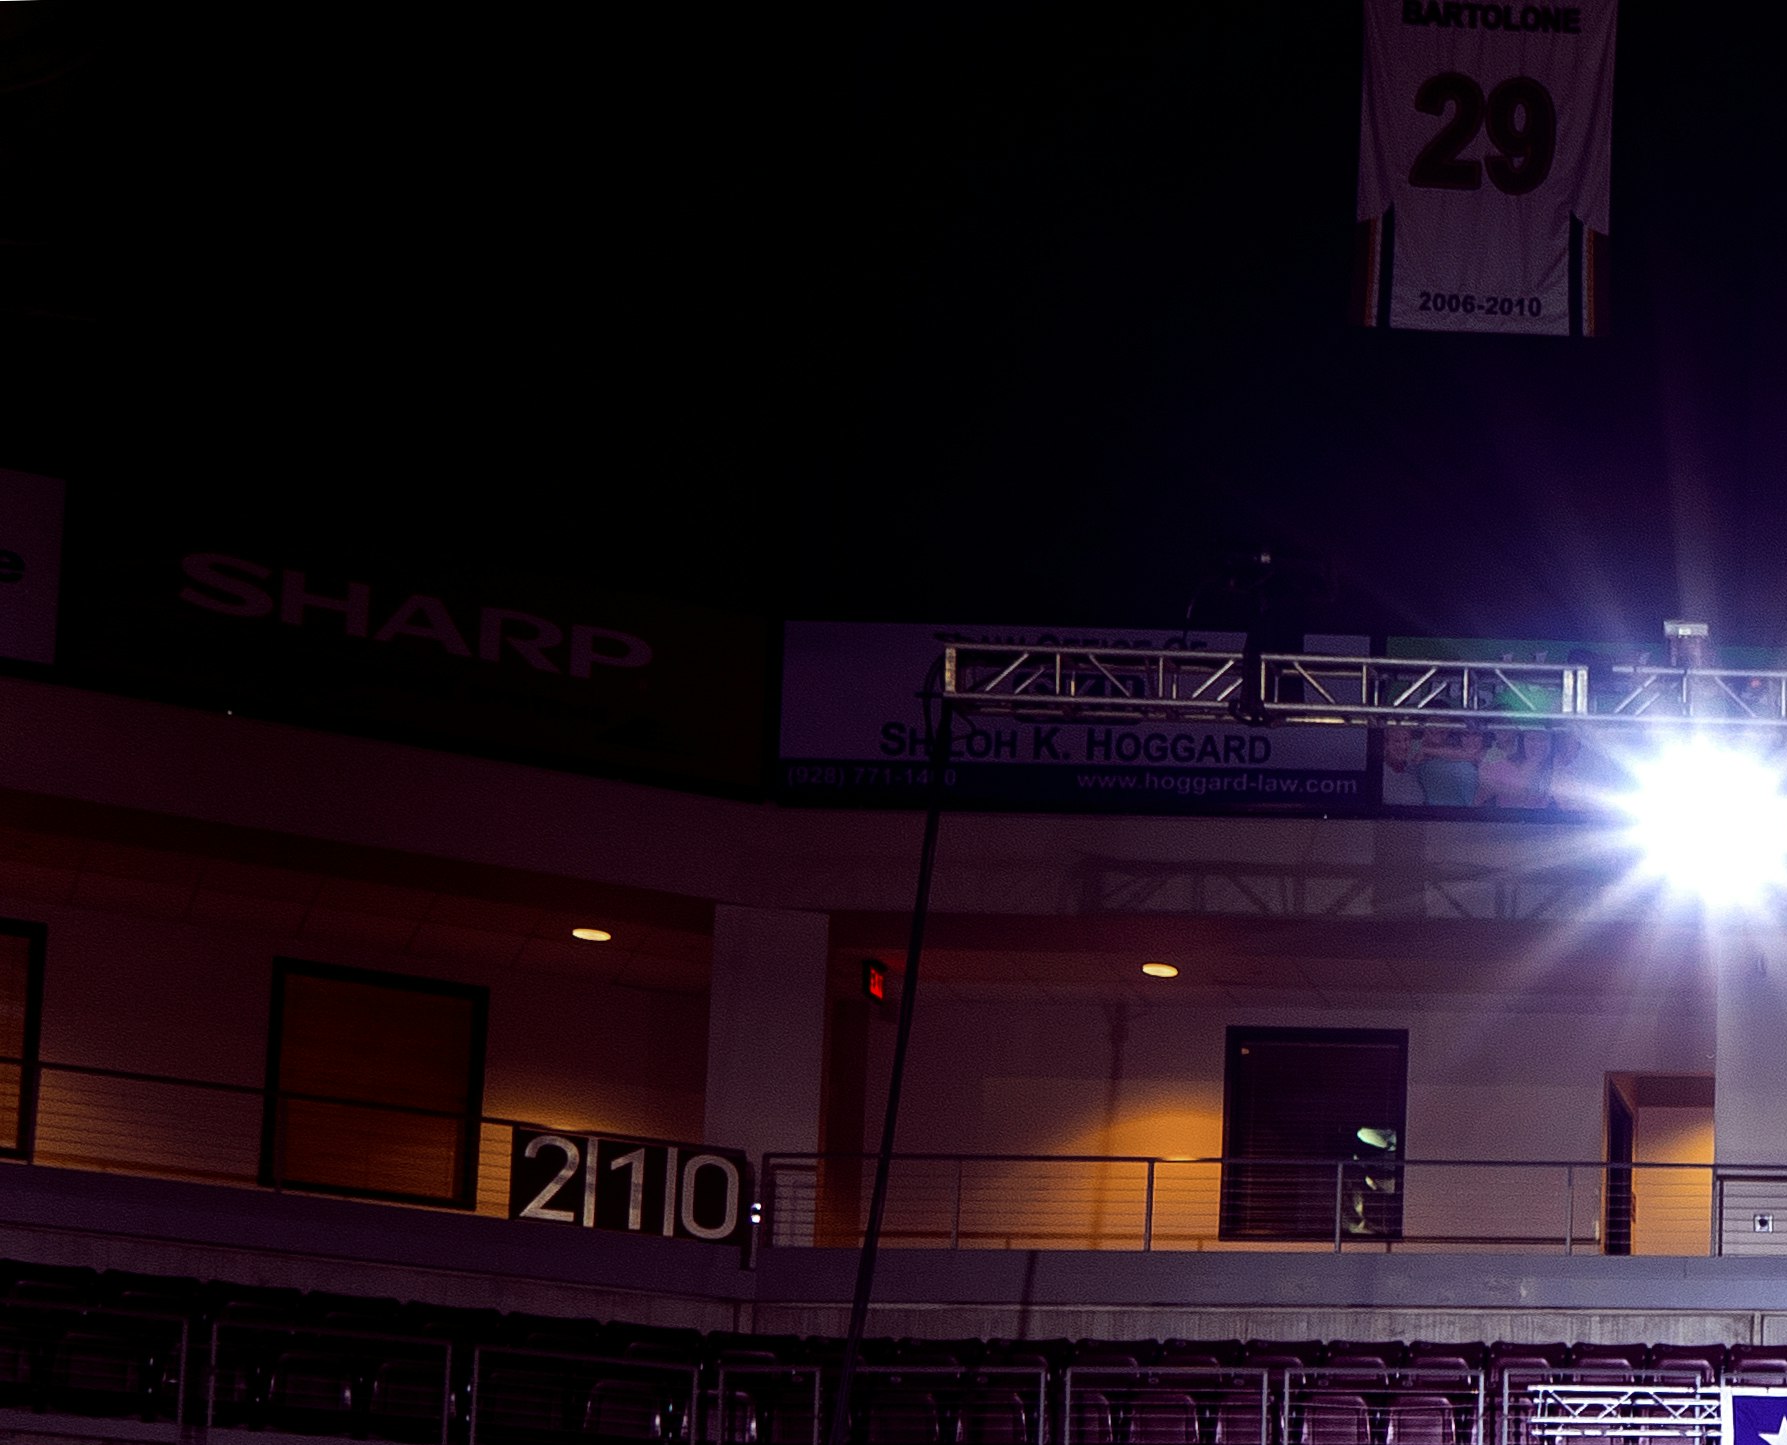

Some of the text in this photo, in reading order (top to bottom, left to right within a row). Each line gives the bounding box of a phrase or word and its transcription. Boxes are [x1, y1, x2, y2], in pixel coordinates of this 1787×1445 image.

[1402, 0, 1582, 33] BARTOLONE
[1409, 71, 1556, 195] 29
[1419, 292, 1542, 316] 2006-2010
[178, 550, 653, 681] SHARP
[880, 722, 1272, 764] SHLOH K. HOGGARD
[787, 766, 957, 789] (928) 771-140
[1076, 770, 1358, 796] www.hoggard-law.com
